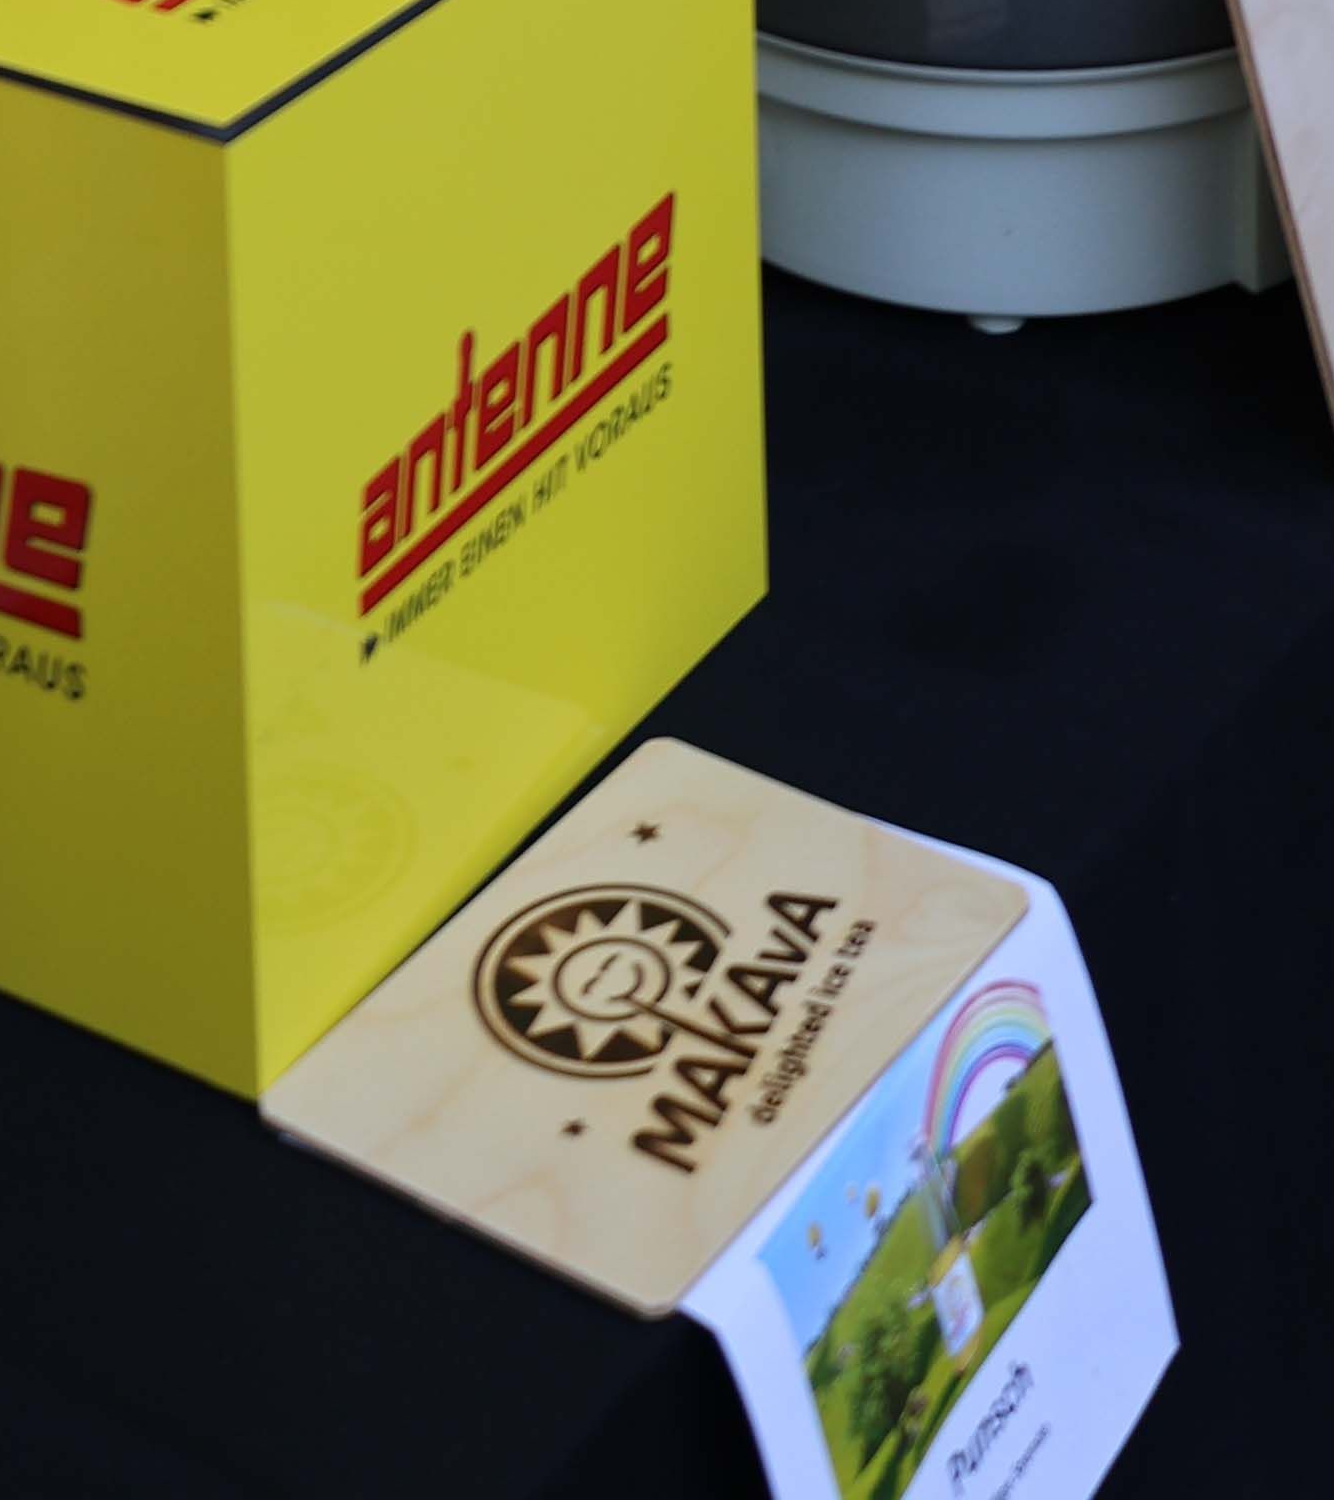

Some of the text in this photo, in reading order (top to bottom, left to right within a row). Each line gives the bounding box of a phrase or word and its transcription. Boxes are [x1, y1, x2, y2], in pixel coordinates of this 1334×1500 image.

[356, 189, 676, 580] antenne
[382, 360, 674, 644] IMMER EINEN HIT VORAUS
[750, 920, 877, 1125] delighted ice tea
